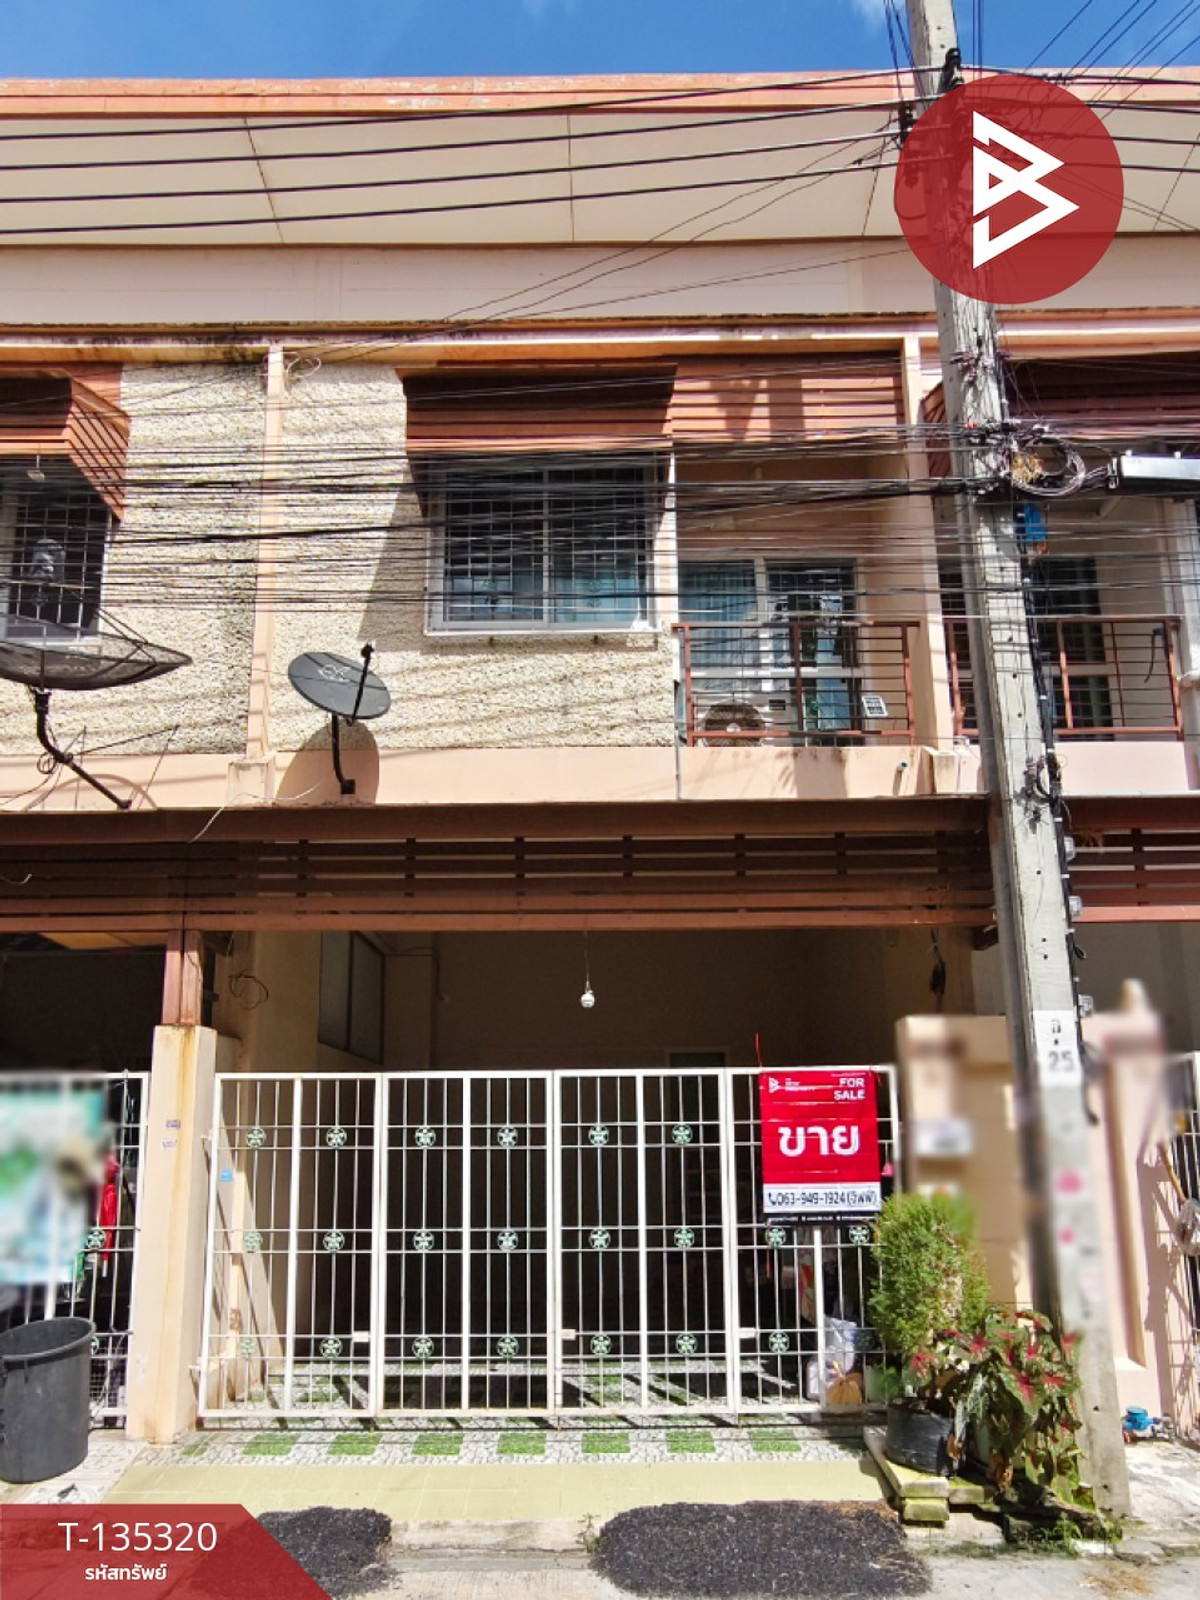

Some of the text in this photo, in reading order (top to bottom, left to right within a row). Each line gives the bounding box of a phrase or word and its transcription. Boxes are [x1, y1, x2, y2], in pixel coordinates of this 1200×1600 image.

[839, 1077, 866, 1088] FOR
[833, 1089, 866, 1101] SALE
[778, 1125, 860, 1157] ขาย
